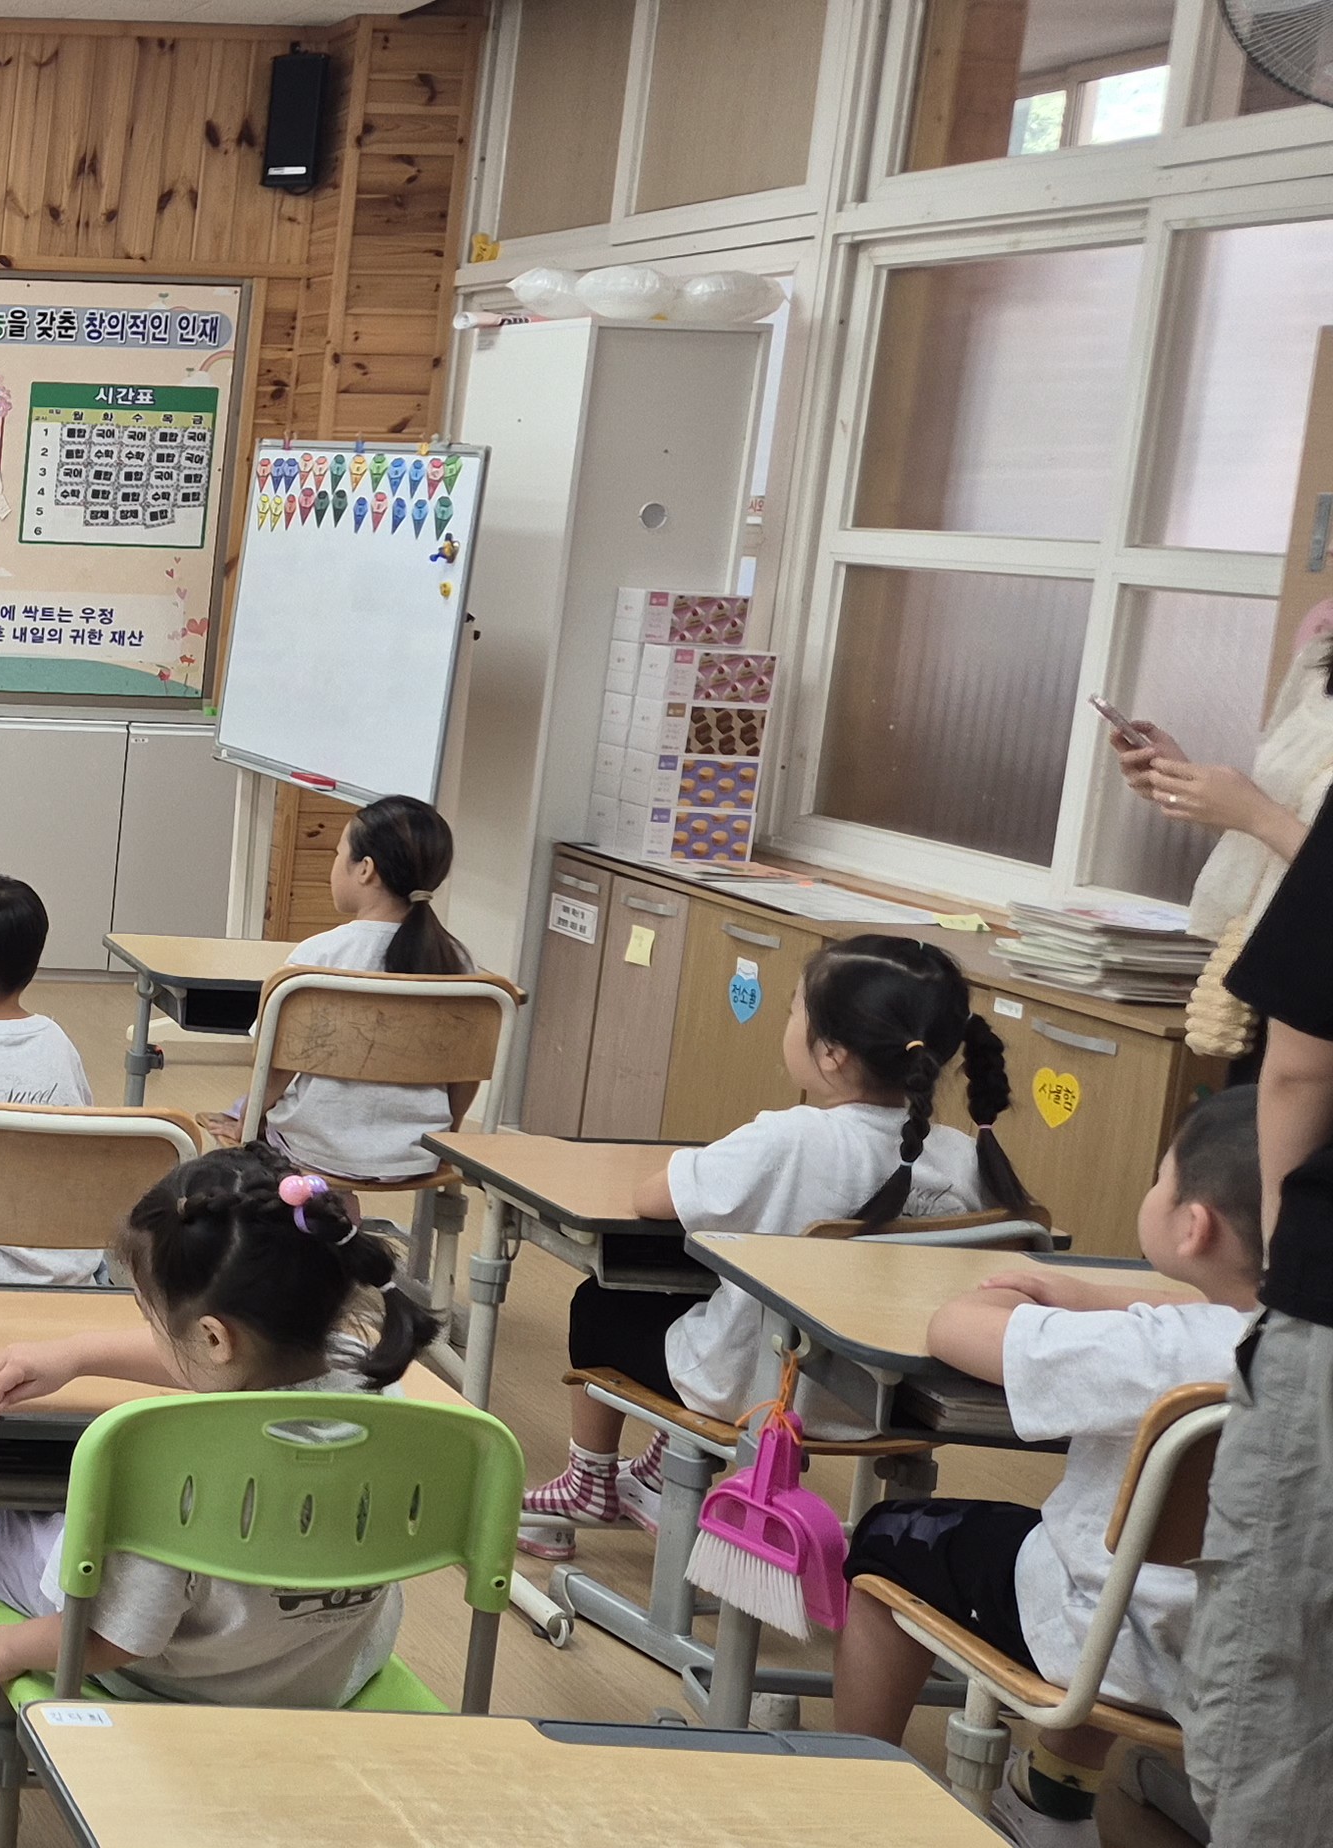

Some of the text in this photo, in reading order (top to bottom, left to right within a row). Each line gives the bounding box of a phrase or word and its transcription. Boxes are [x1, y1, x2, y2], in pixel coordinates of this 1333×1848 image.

[35, 310, 77, 340] 갖춘
[84, 311, 170, 344] 창의적인
[177, 313, 220, 345] 인재
[95, 387, 155, 405] 시간표
[132, 413, 143, 423] 수
[192, 414, 203, 425] 금
[43, 428, 48, 437] 1
[96, 428, 115, 439] 국어
[127, 430, 146, 441] 국어
[187, 431, 207, 442] 국어
[41, 447, 48, 457] 2
[184, 452, 205, 464] 국어
[39, 467, 47, 477] 3
[63, 468, 82, 478] 국어
[154, 471, 173, 481] 국어
[37, 487, 45, 496] 4
[36, 507, 44, 516] 5
[34, 527, 42, 536] 6
[22, 605, 74, 624] 싹트는
[78, 606, 115, 625] 우정
[12, 625, 63, 645] 내일의
[69, 627, 103, 646] 귀한
[109, 628, 144, 647] 재산
